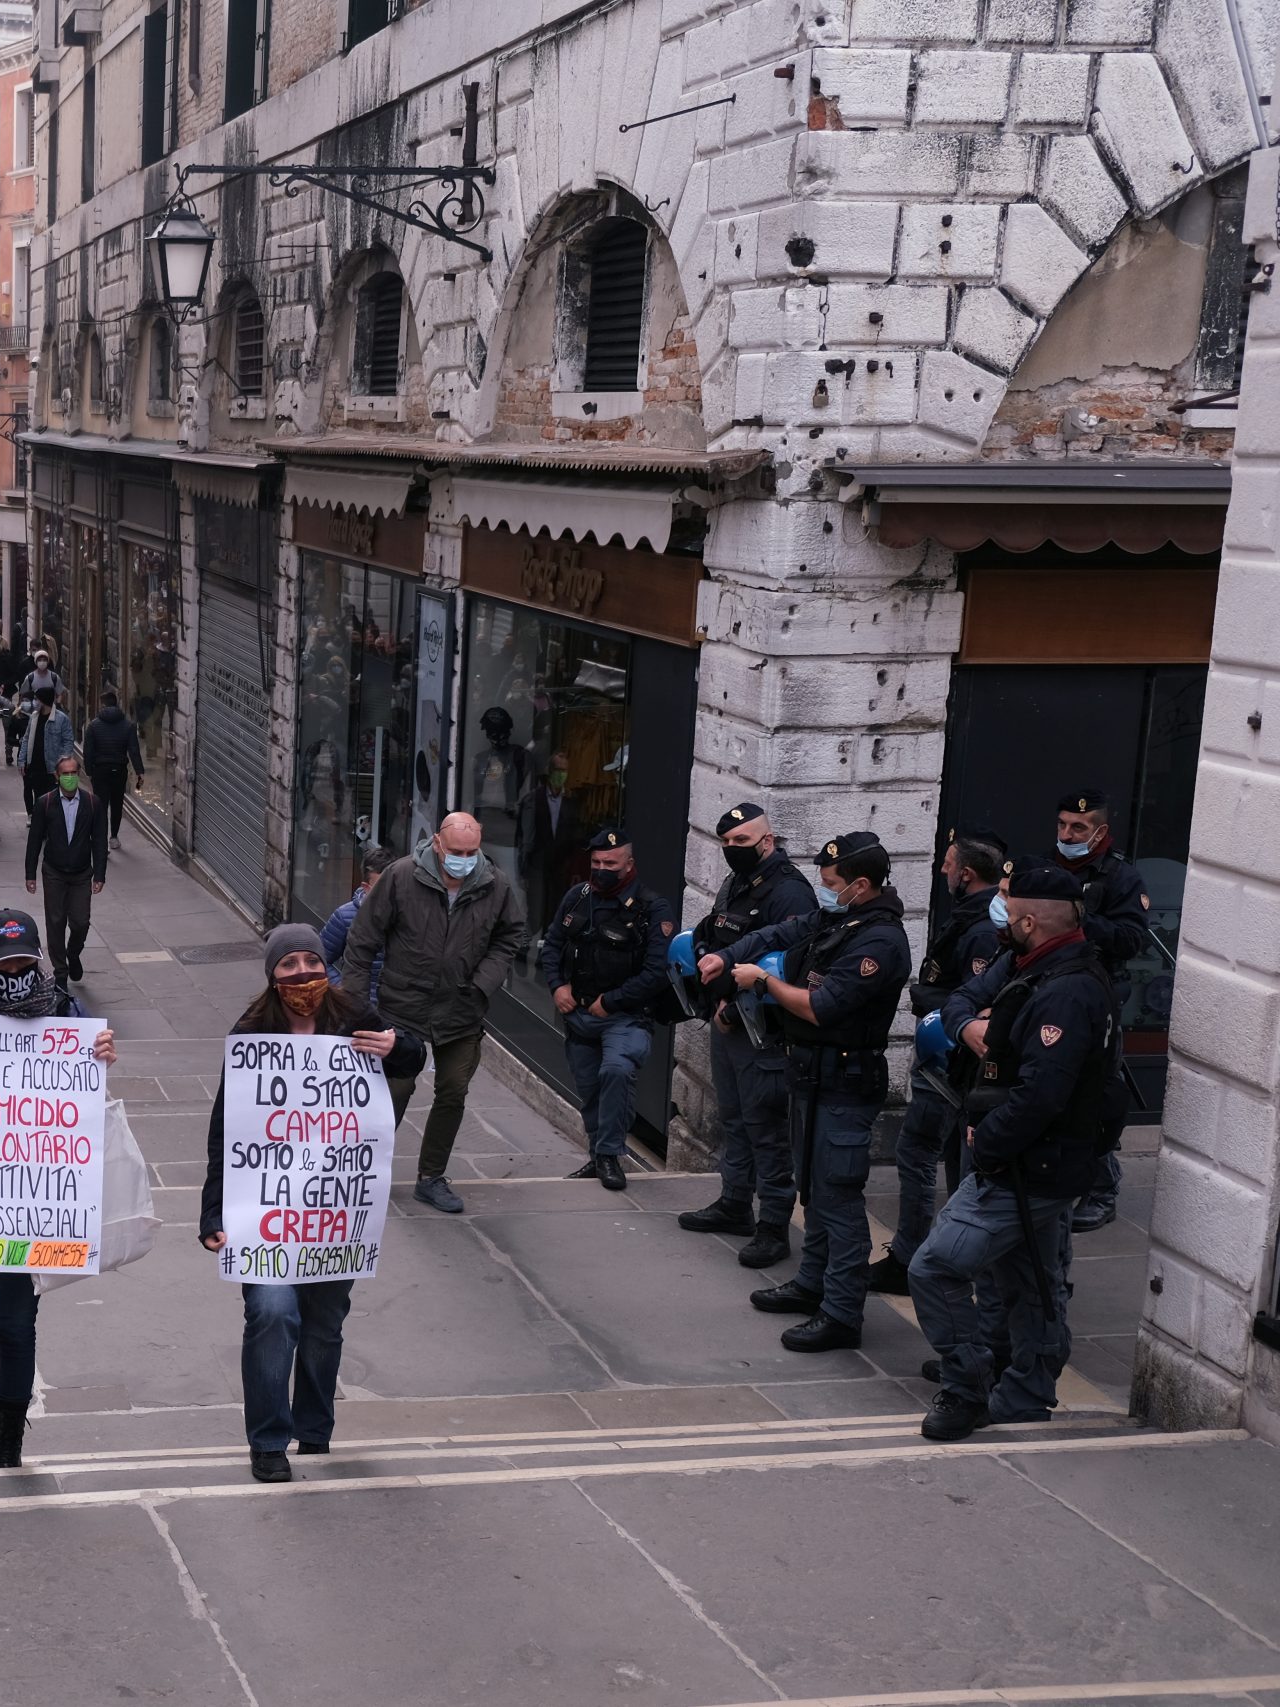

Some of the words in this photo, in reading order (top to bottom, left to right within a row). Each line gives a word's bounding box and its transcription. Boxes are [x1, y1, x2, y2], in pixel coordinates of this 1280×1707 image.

[556, 547, 604, 616] Shop
[42, 1028, 80, 1055] 575
[231, 1041, 295, 1071] SOPRA
[301, 1047, 321, 1073] la
[329, 1043, 381, 1074] GENTE
[21, 1057, 100, 1092] ACCUSATO
[256, 1073, 287, 1107] LO
[302, 1073, 371, 1108] STATO
[231, 1141, 294, 1170] SOTTO
[299, 1147, 316, 1172] lo
[322, 1142, 373, 1173] STATO
[260, 1172, 291, 1207] LA
[302, 1171, 377, 1207] GENTE
